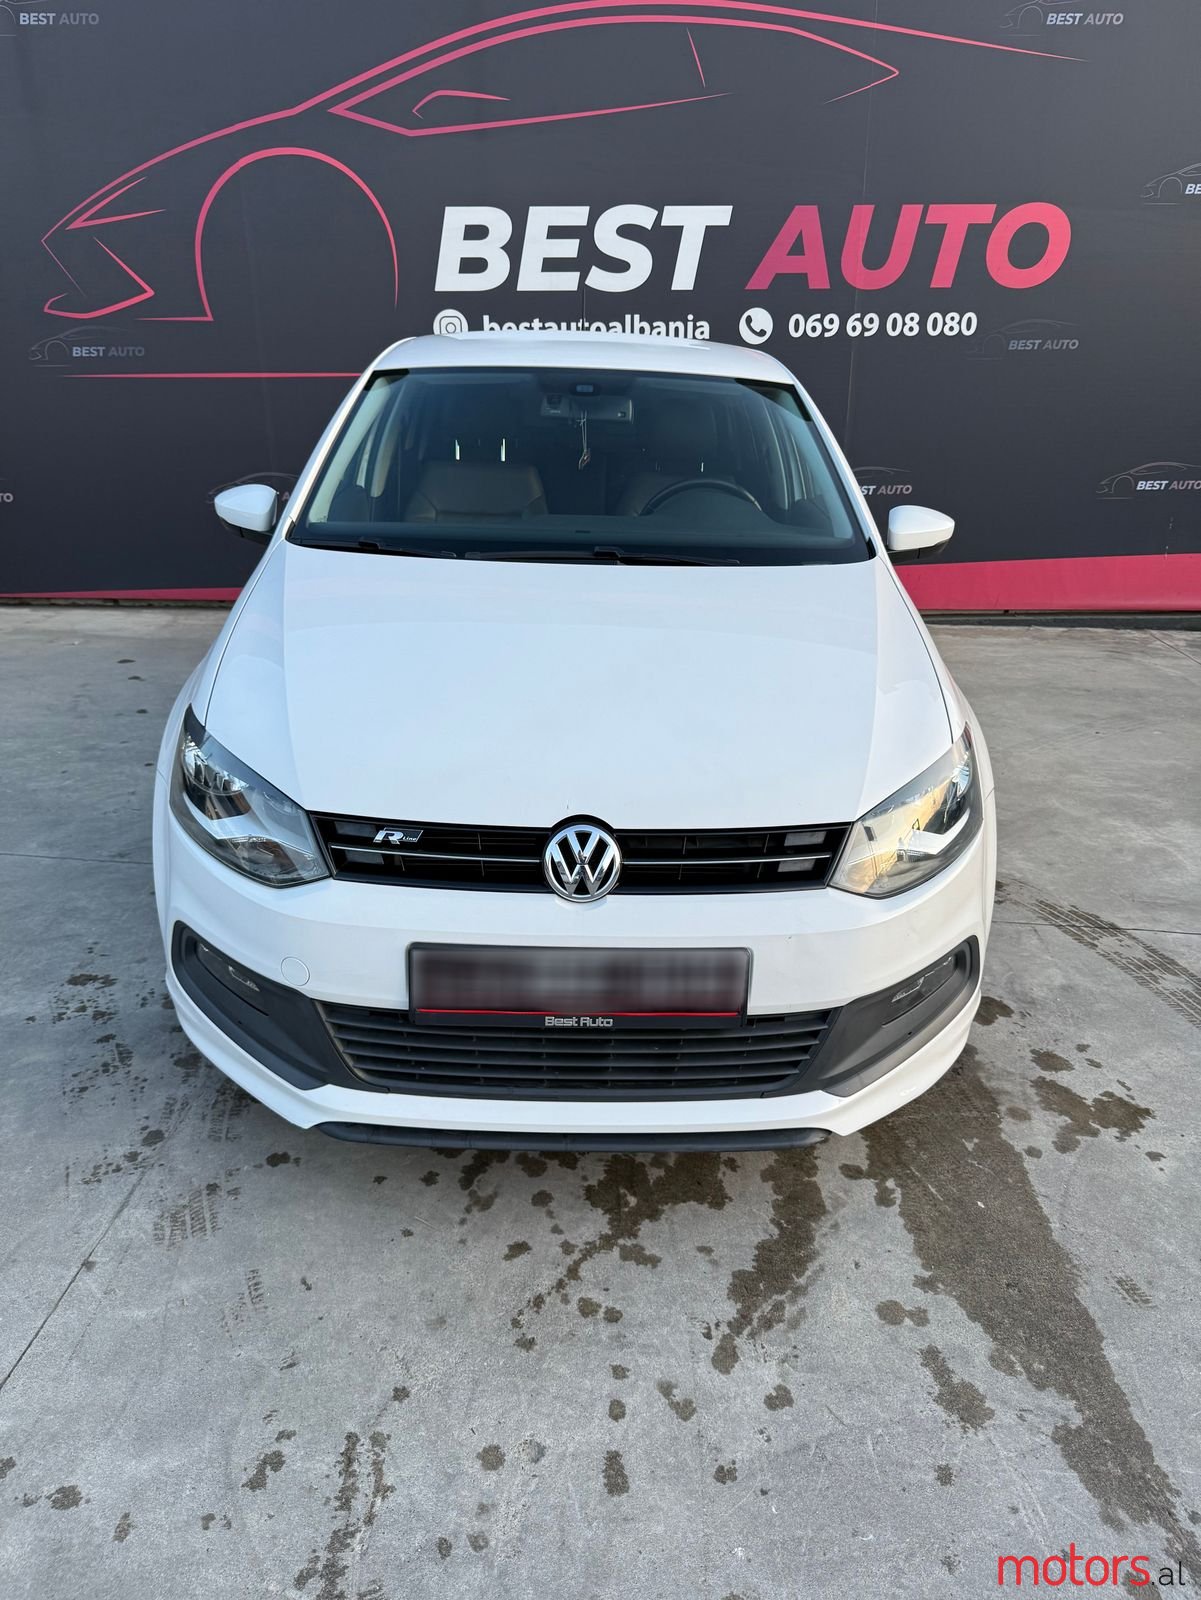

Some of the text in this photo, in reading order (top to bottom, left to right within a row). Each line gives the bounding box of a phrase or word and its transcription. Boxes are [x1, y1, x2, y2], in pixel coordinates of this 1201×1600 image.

[20, 13, 99, 25] BEST AUTO
[1046, 12, 1124, 25] BEST AUTO
[435, 202, 1072, 293] BEST AUTO
[788, 311, 978, 338] 069 69 08 080
[1008, 339, 1079, 350] BEST AUTO
[72, 346, 145, 357] BEST AUTO
[877, 484, 912, 495] AUTO
[1136, 480, 1201, 490] BEST AUTO
[373, 830, 404, 845] R
[544, 1016, 613, 1027] Best Auto
